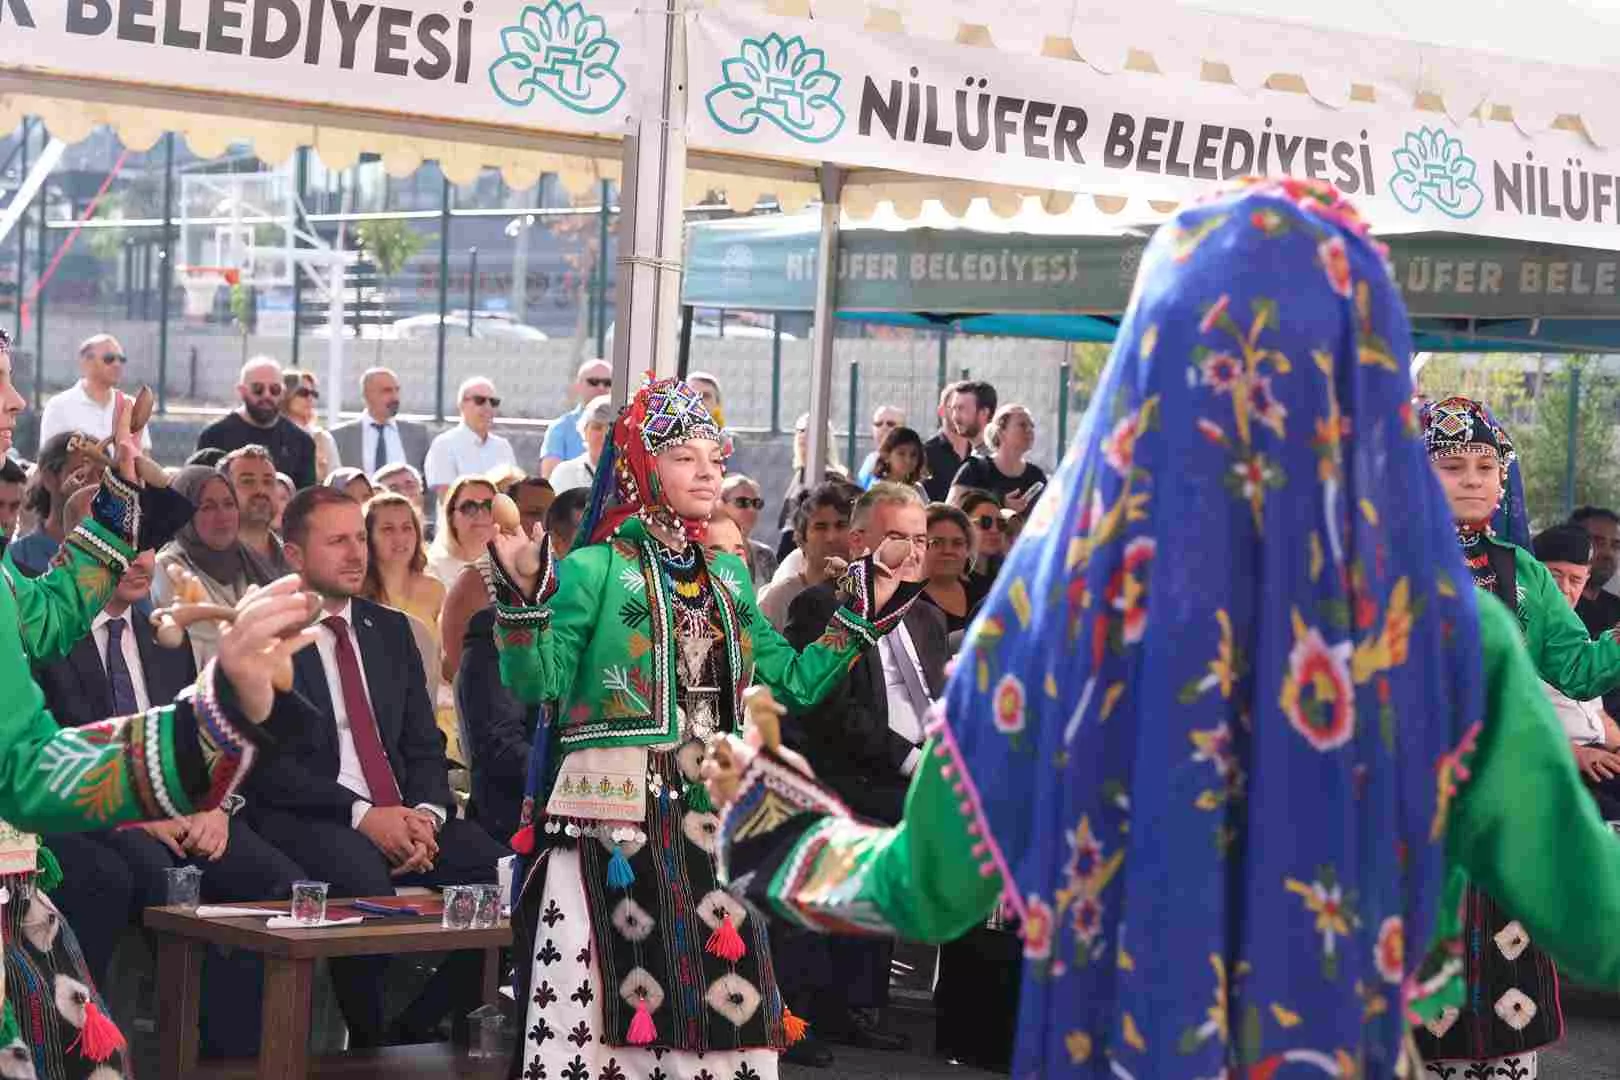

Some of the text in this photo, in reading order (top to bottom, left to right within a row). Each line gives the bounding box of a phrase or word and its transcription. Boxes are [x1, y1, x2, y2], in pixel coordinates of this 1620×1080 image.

[858, 66, 1377, 196] NİLÜFER BELEDİYESİ
[910, 249, 1079, 282] BELEDİYESİ
